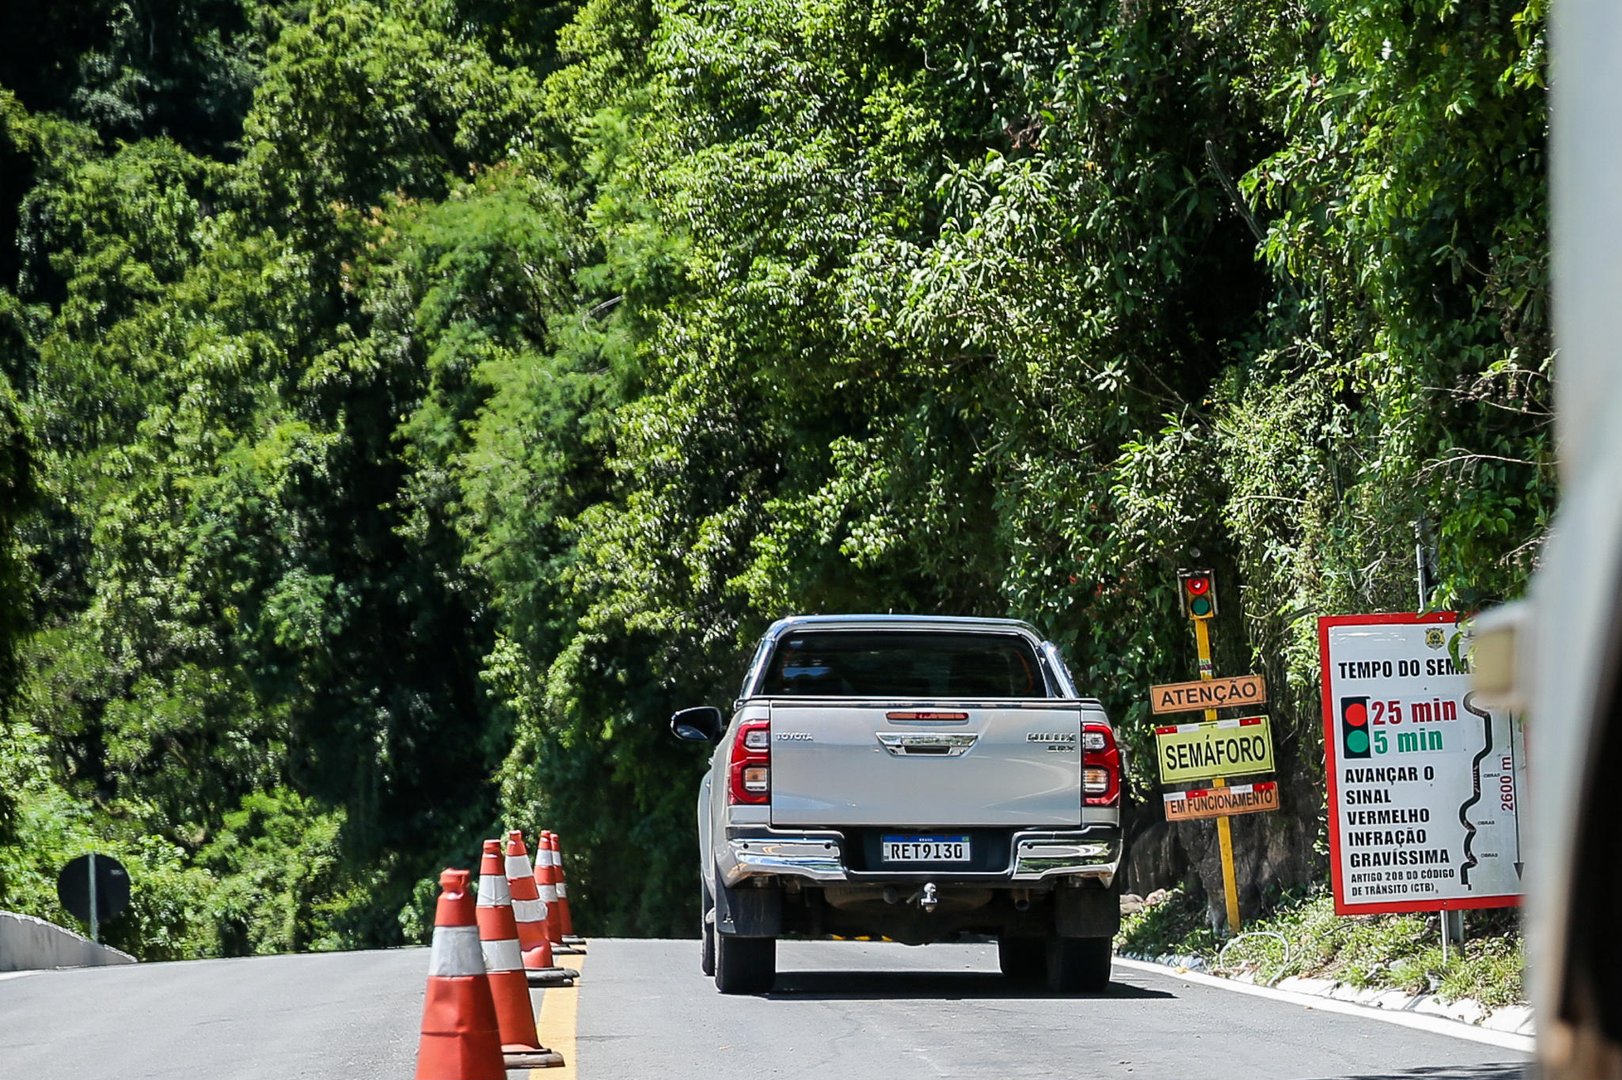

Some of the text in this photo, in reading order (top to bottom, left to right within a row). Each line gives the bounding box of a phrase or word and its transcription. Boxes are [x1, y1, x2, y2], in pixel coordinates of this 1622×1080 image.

[1338, 654, 1471, 679] TEMPO DO SEMÁ
[1161, 680, 1257, 707] ATENÇÃO
[1371, 698, 1457, 725] 25 min
[776, 732, 814, 741] TOYOTA
[1374, 728, 1443, 755] 5 min
[1165, 734, 1266, 770] SEMÁFORO
[1345, 766, 1434, 785] AVANÇAR O
[1501, 757, 1514, 811] 2600 m
[1171, 791, 1273, 813] EM FUNCIONAMENTO
[1346, 789, 1391, 804] SINAL
[1347, 808, 1430, 825] VERMELHO
[1349, 827, 1427, 848] INFRAÇÃO
[1350, 848, 1450, 868] GRAVÍSSIMA
[1351, 868, 1455, 883] ARTIGO 208 DO CÓDIGO
[1351, 883, 1435, 896] DE TRÂNSITO (CTB)
